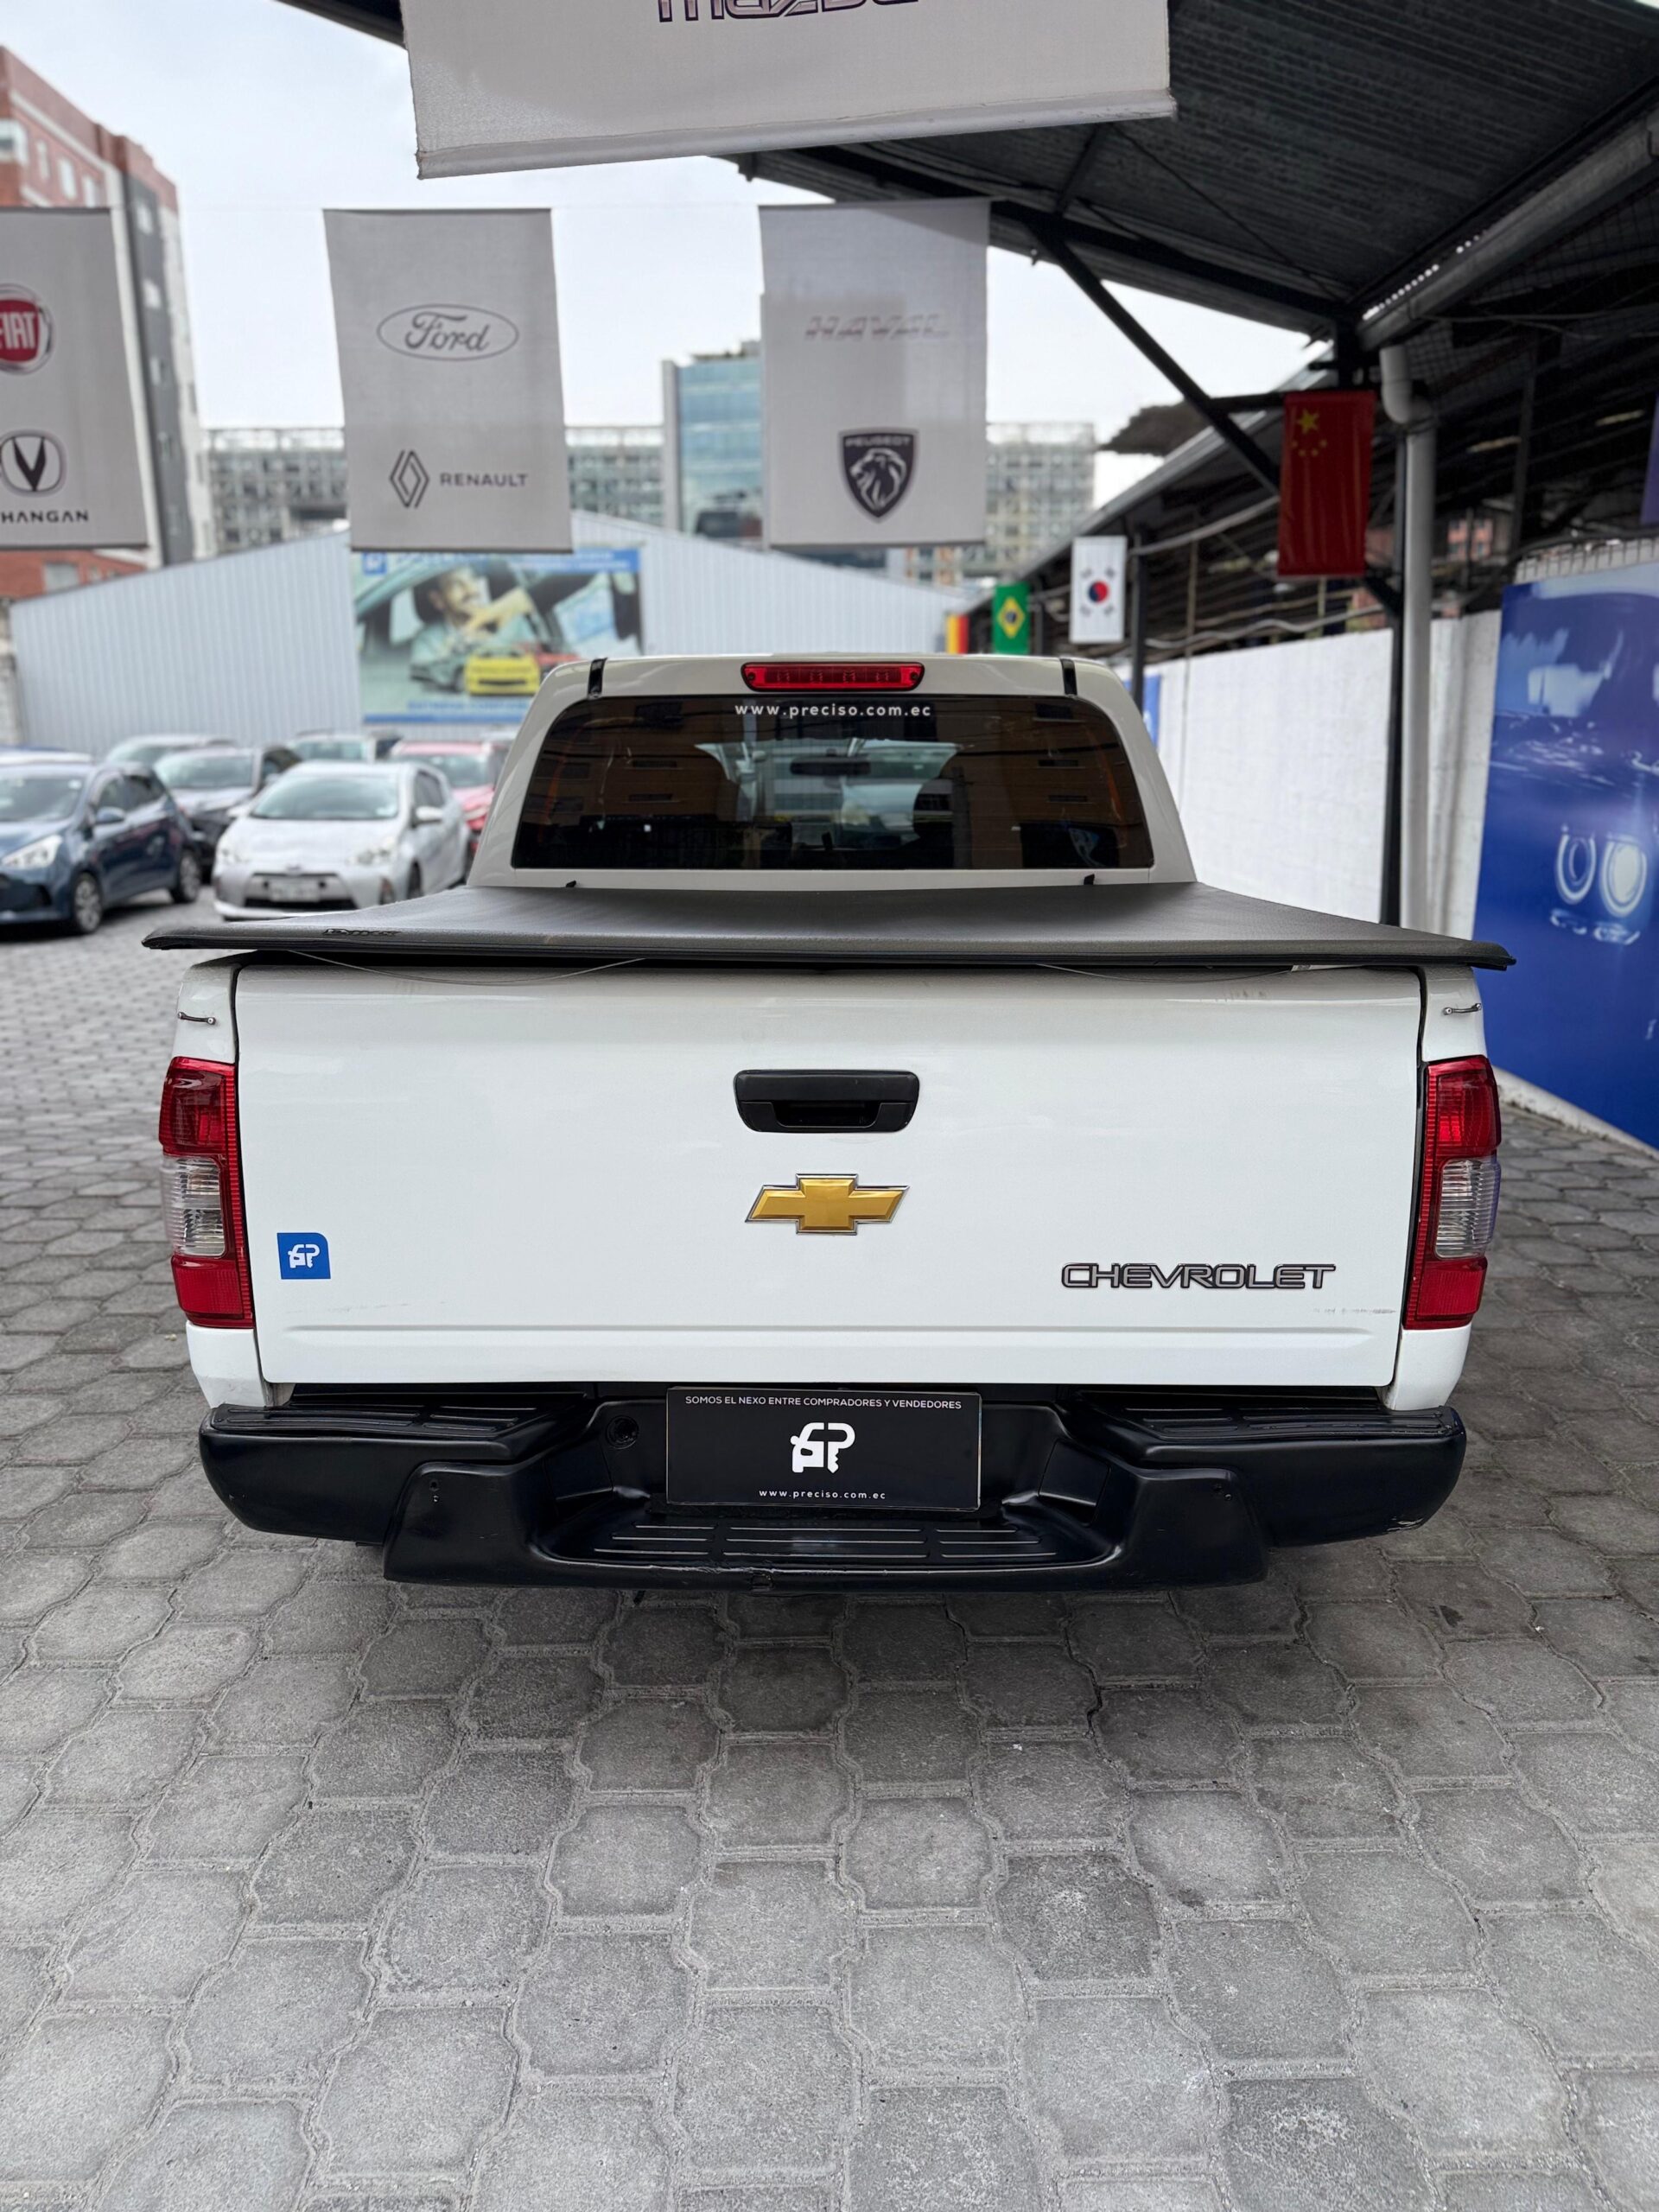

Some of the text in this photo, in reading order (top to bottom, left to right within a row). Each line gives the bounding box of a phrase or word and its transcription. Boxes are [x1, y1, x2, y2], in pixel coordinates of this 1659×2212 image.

[404, 311, 490, 351] Ford
[439, 472, 528, 487] RENAULT
[0, 510, 89, 524] HANGAN
[734, 702, 931, 720] www.preciso.com.ec
[1061, 1262, 1337, 1289] CHEVROLET
[685, 1395, 962, 1409] SOMOS EL NEXO ENTRE COMPRADORES Y VENDEDORES
[759, 1490, 886, 1499] www.preciso.com.ec
